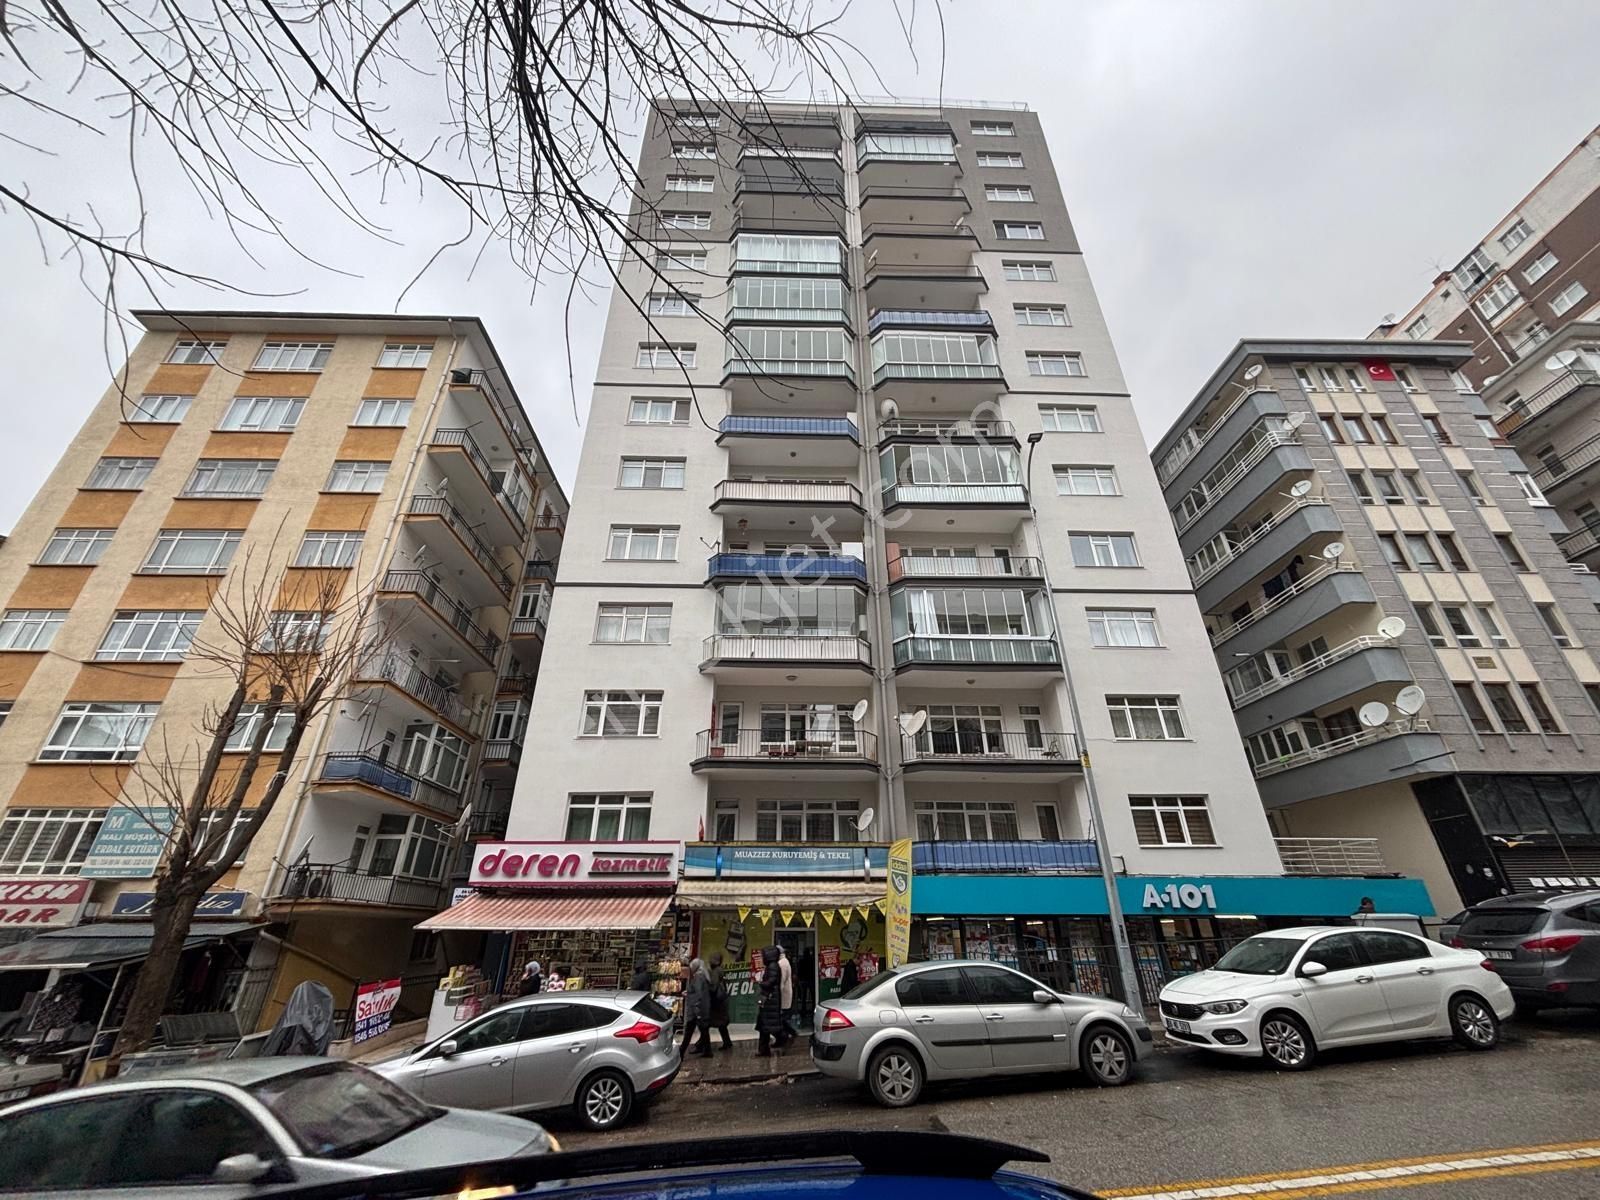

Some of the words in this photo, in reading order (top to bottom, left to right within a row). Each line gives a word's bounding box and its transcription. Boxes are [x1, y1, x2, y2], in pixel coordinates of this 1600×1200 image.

[477, 848, 581, 877] deren
[591, 856, 671, 872] kozmetik
[734, 850, 770, 859] MUAZZEZ
[772, 850, 818, 861] KURUYEMİŞ
[819, 852, 826, 860] &
[827, 851, 851, 860] TEKEL
